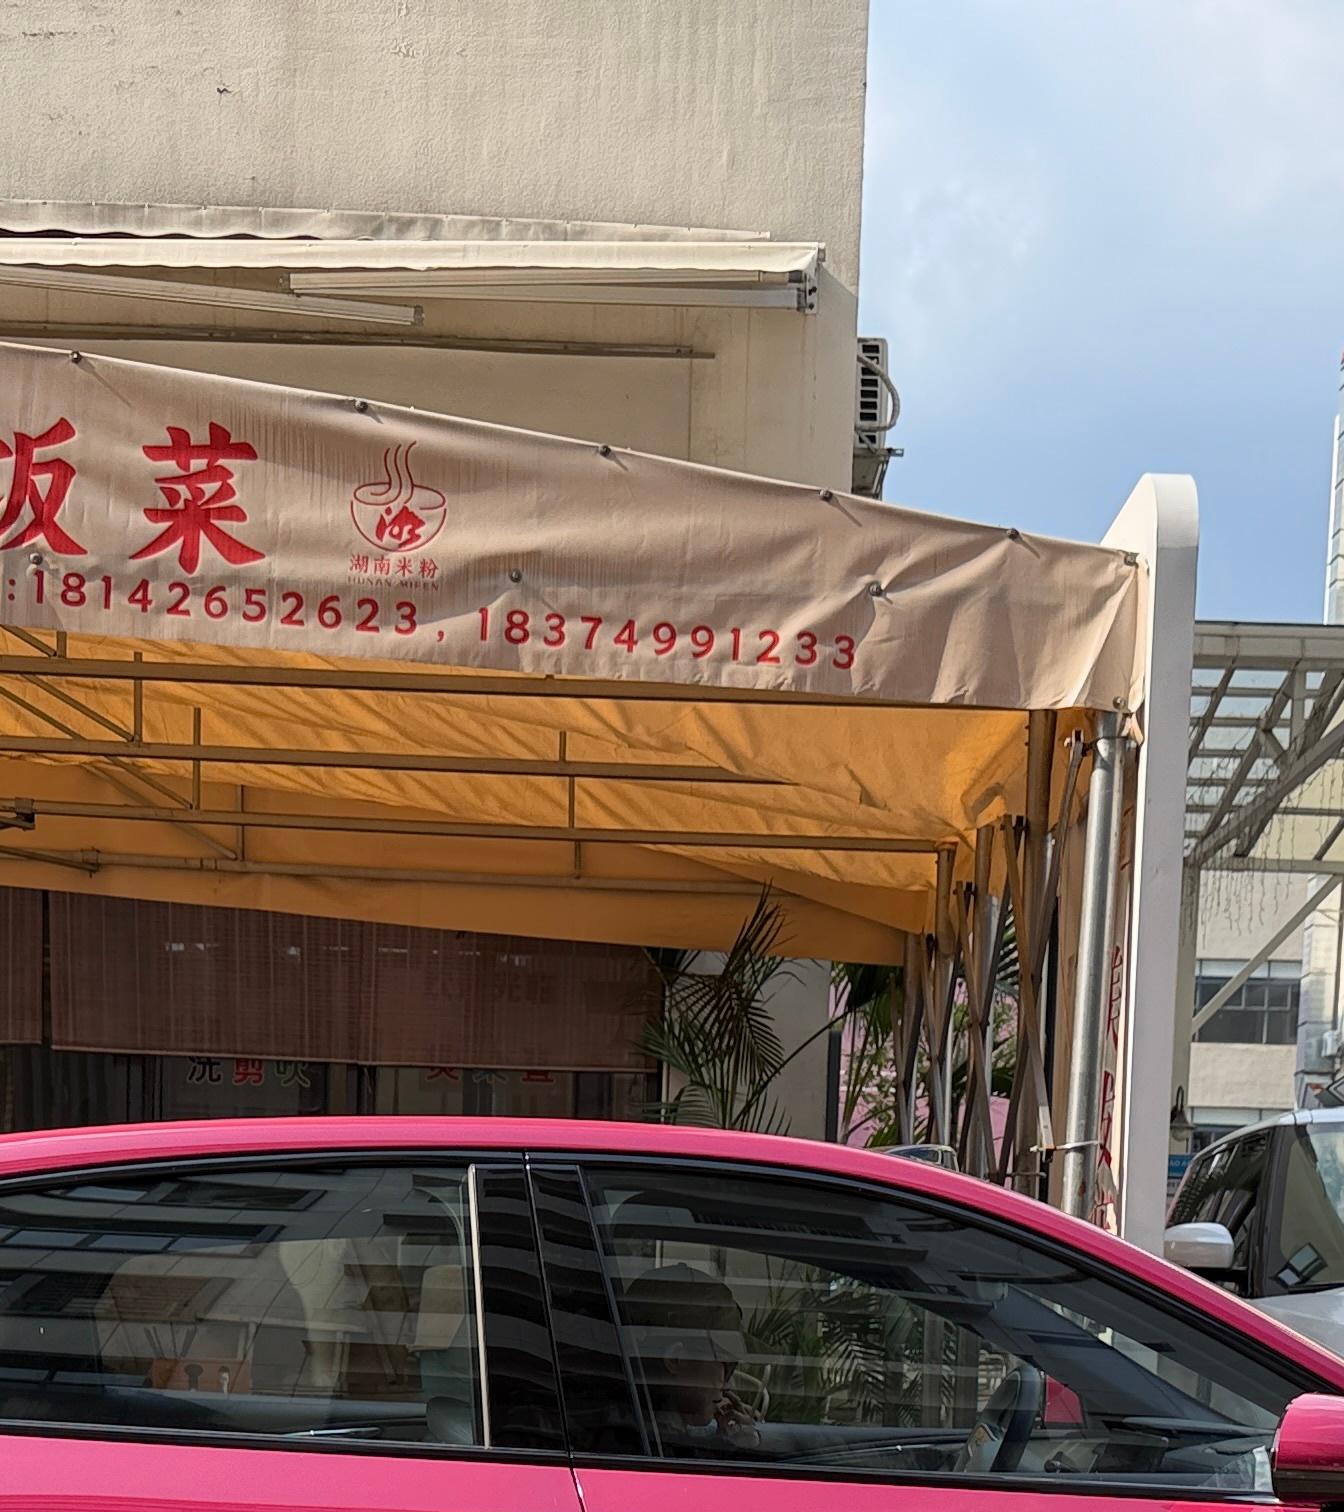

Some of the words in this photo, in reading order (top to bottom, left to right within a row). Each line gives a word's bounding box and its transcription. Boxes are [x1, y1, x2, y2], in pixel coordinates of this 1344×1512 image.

[349, 553, 439, 579] 湖南米粉
[478, 606, 856, 670] 18374991233
